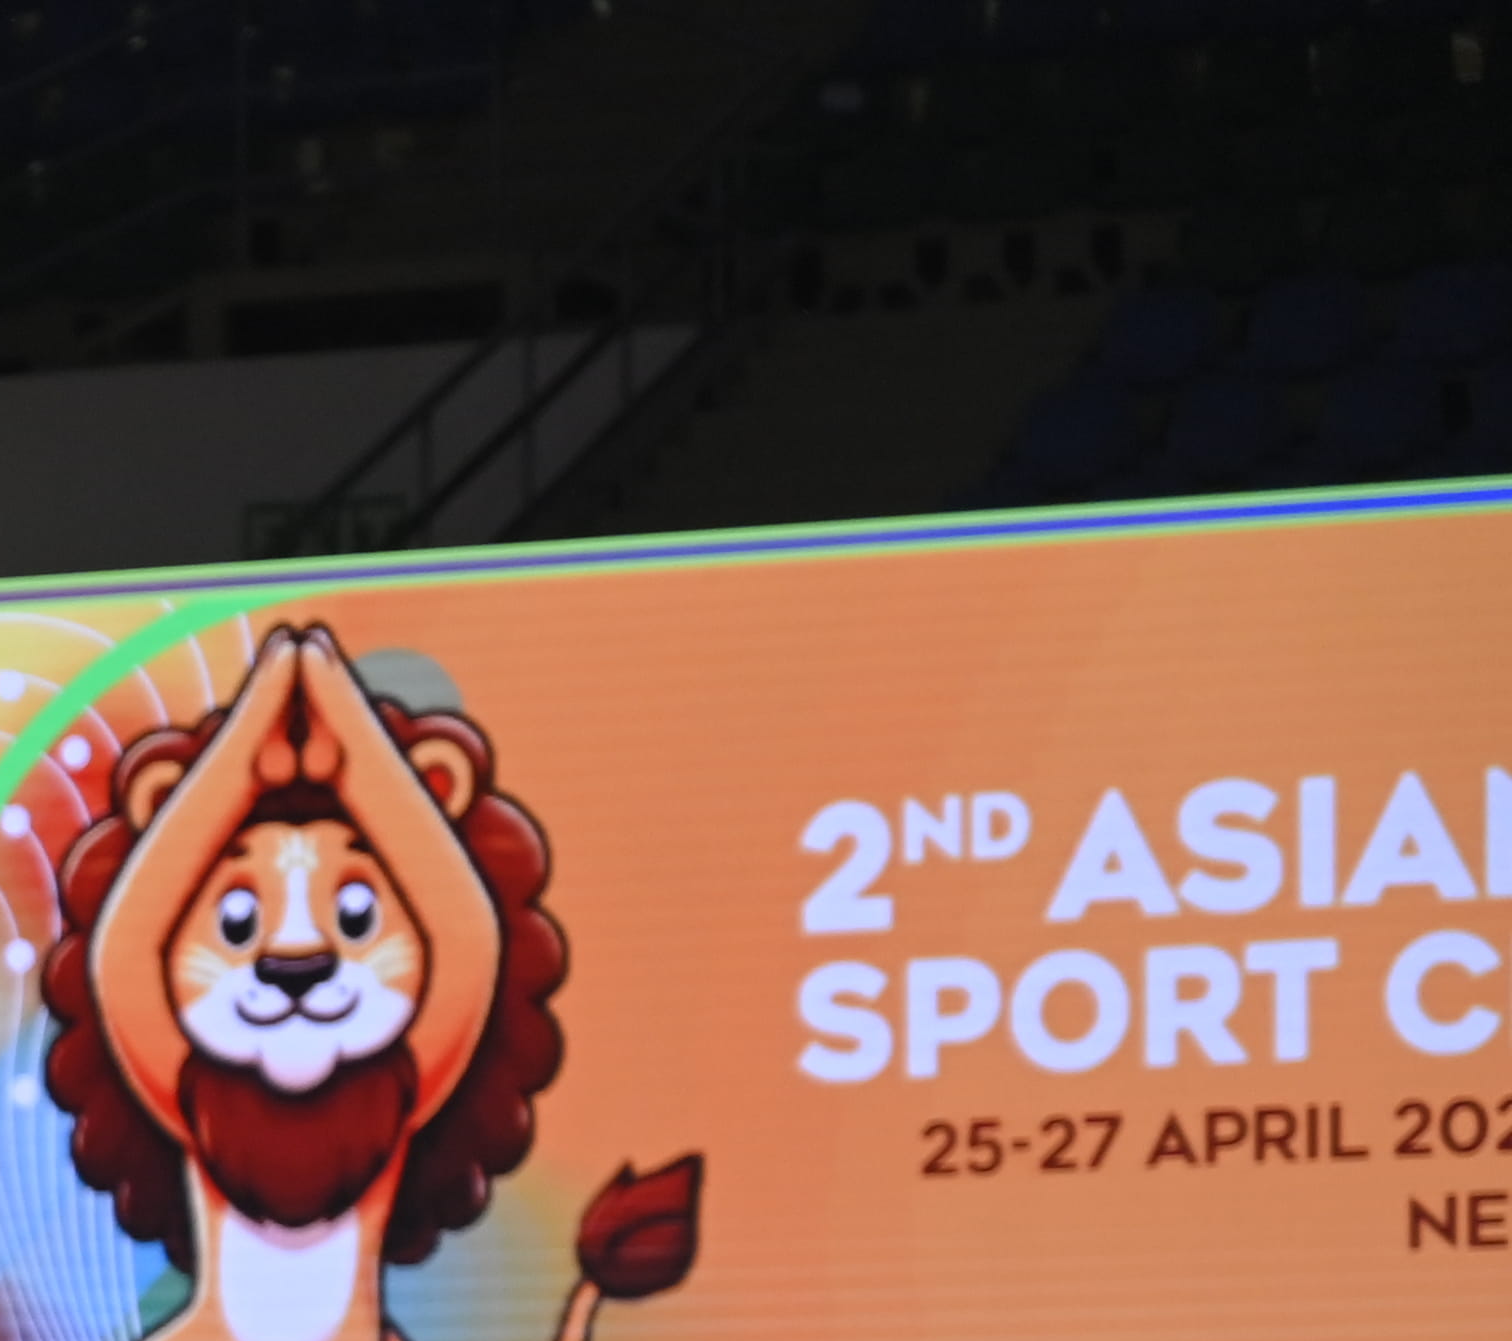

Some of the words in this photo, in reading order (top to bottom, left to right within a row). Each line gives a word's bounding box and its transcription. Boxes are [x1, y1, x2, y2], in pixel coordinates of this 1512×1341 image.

[798, 790, 1032, 935] 2ND
[796, 937, 1341, 1084] SPORT
[1384, 929, 1512, 1057] C
[920, 1113, 1124, 1178] 25-27
[1146, 1102, 1369, 1169] APRIL
